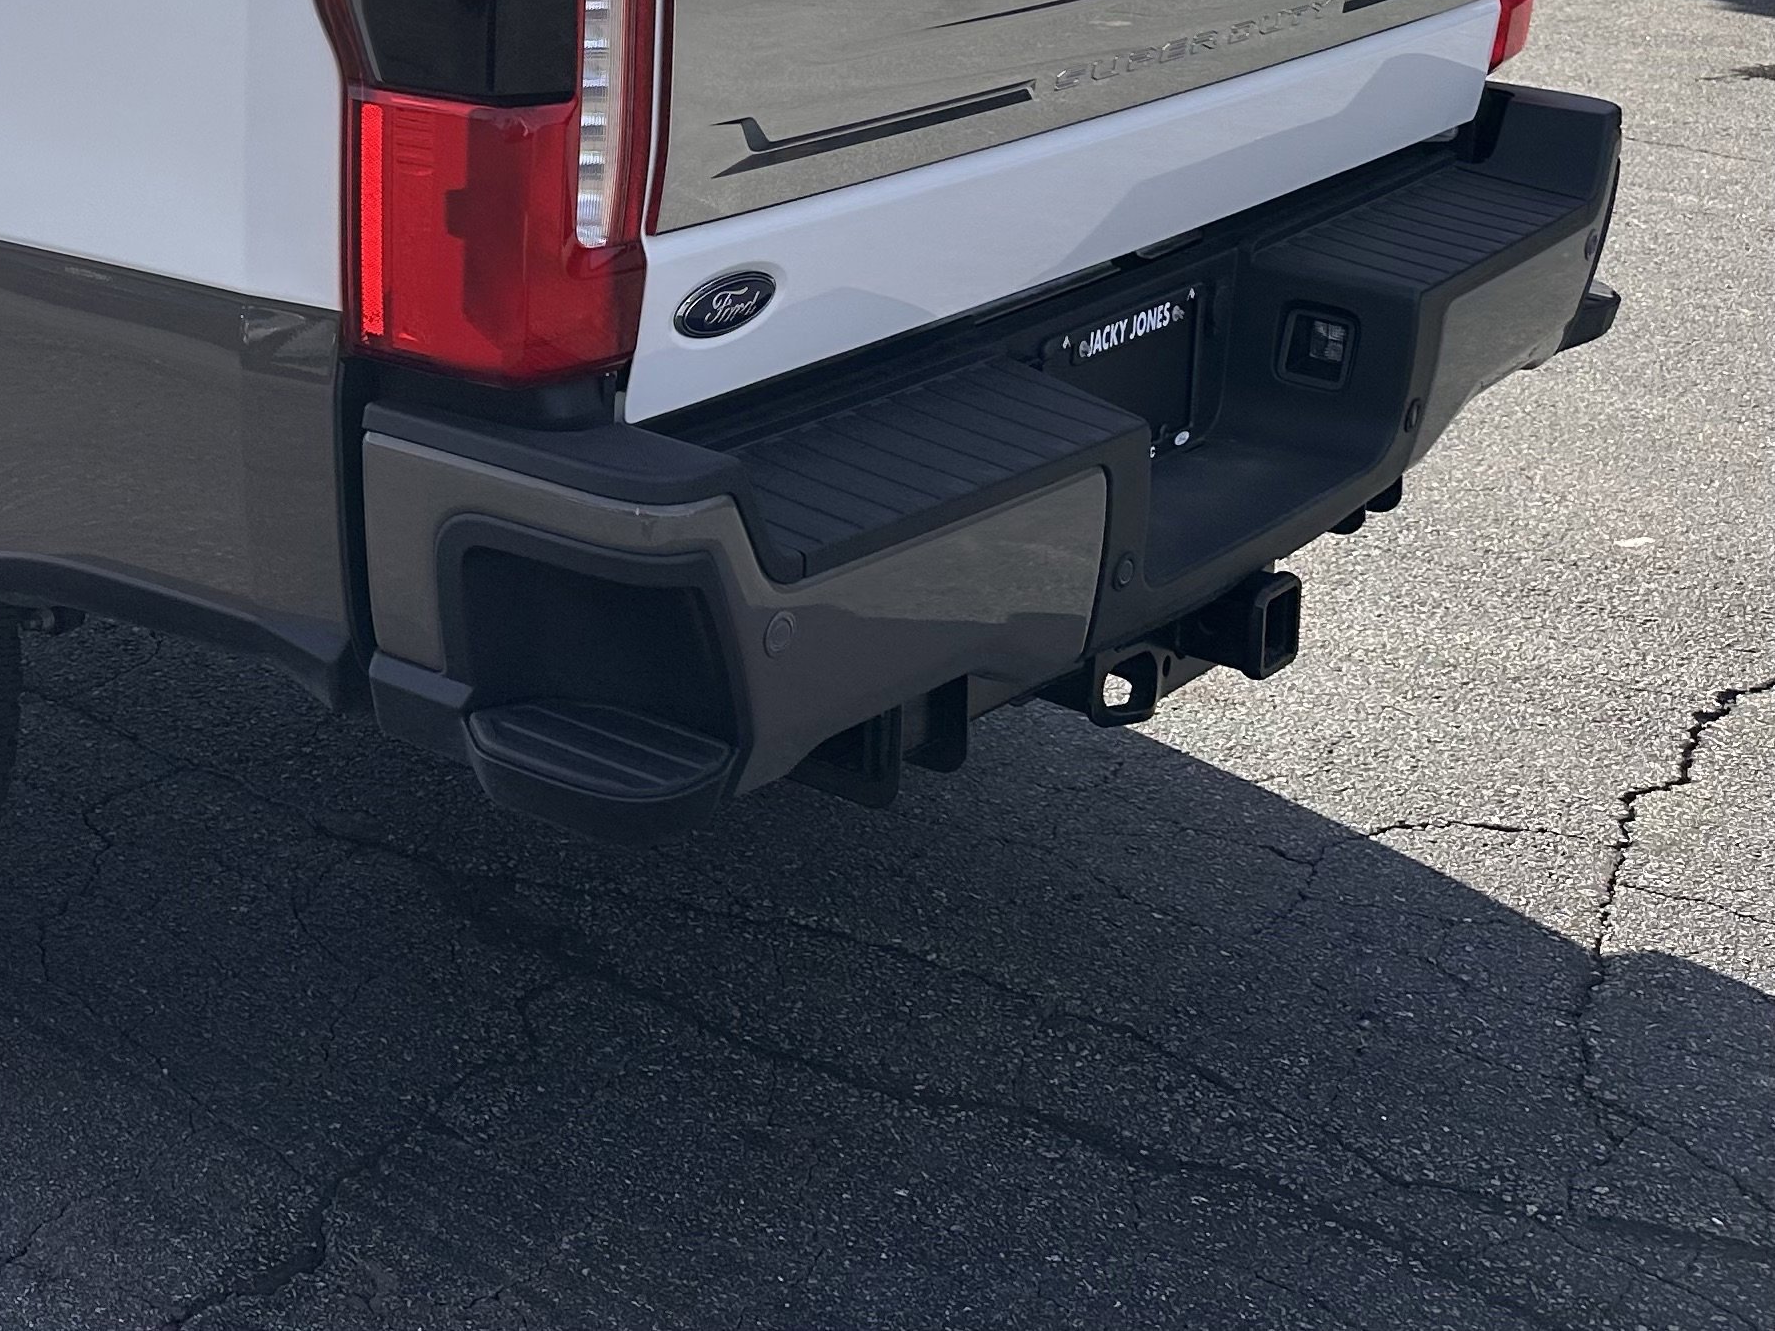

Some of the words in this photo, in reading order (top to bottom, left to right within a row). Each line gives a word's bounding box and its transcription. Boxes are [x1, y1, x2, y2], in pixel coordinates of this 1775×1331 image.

[1054, 30, 1218, 92] SUPER
[704, 286, 761, 324] Ford
[1086, 318, 1129, 358] JACKY
[1129, 301, 1171, 340] JONES
